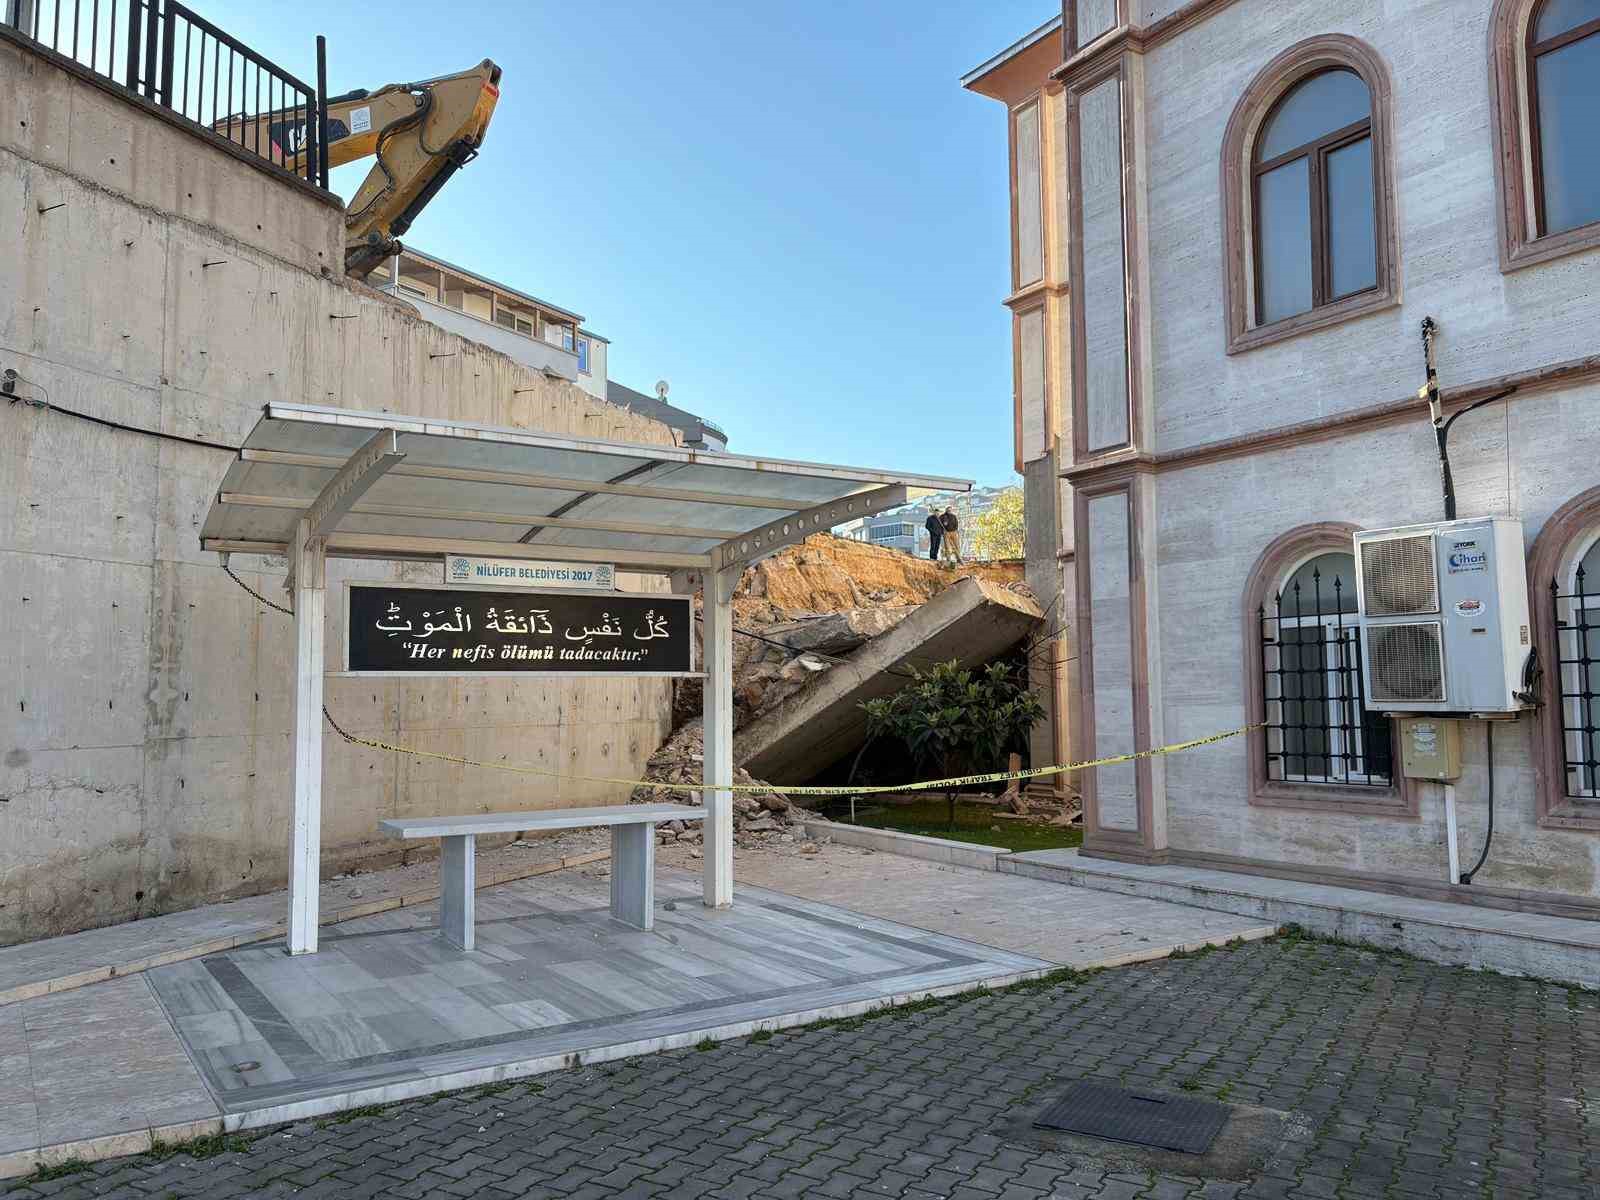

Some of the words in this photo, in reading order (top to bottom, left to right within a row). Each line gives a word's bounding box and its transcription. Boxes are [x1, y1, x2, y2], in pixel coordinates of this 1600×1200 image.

[476, 563, 516, 577] NİLÜFER
[519, 566, 569, 580] BELEDİYESİ
[572, 570, 593, 581] 2017
[452, 644, 496, 663] nefis
[500, 645, 554, 660] ölümü
